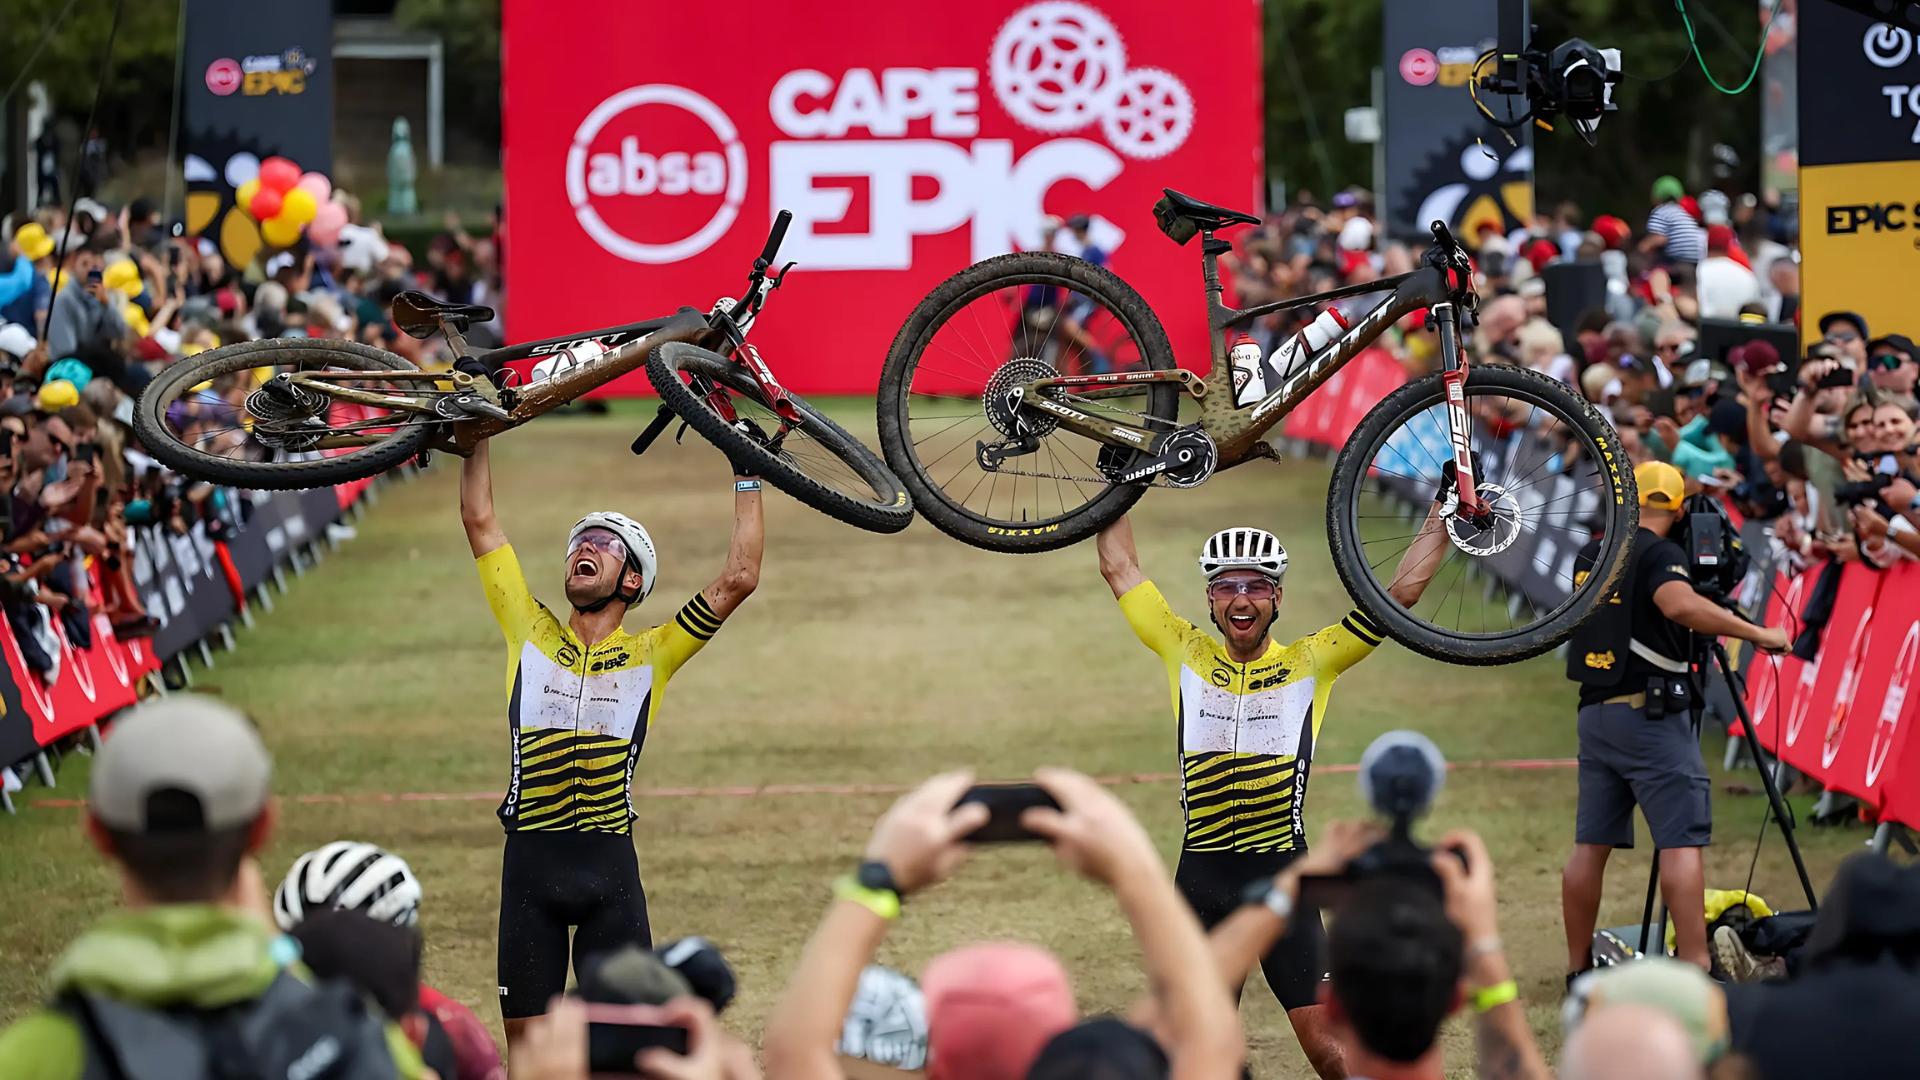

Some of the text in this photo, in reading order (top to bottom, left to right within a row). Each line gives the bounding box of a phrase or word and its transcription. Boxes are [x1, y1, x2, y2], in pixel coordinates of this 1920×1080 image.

[769, 67, 980, 138] CAPE
[587, 136, 727, 196] absa
[769, 138, 1126, 271] EPIC
[1827, 204, 1906, 234] EPIC
[1040, 401, 1089, 421] SCOTT
[1121, 461, 1168, 484] SRAM
[1596, 436, 1625, 506] MAXXIS
[988, 523, 1060, 536] MAXXIS
[508, 767, 520, 805] CAPE
[1293, 773, 1304, 808] CAPE
